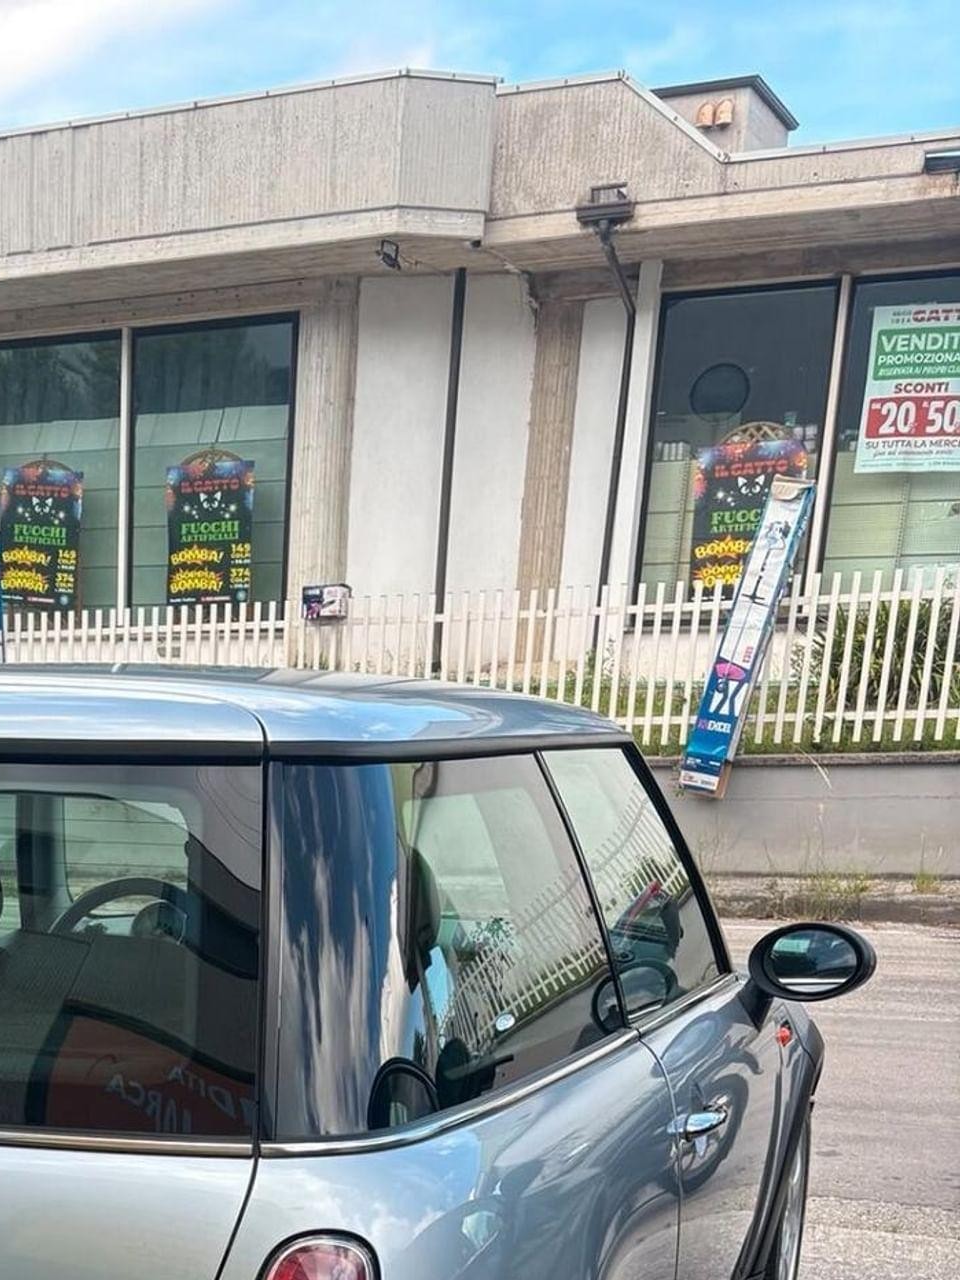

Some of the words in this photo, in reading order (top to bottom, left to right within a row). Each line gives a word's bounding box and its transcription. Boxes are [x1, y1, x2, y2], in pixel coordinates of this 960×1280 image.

[894, 382, 949, 394] SCONTI
[929, 439, 960, 448] MERC
[731, 460, 788, 474] GATTO
[14, 524, 66, 537] FUOCHI
[181, 520, 239, 535] FUOCHI
[170, 548, 224, 565] BOMBA!
